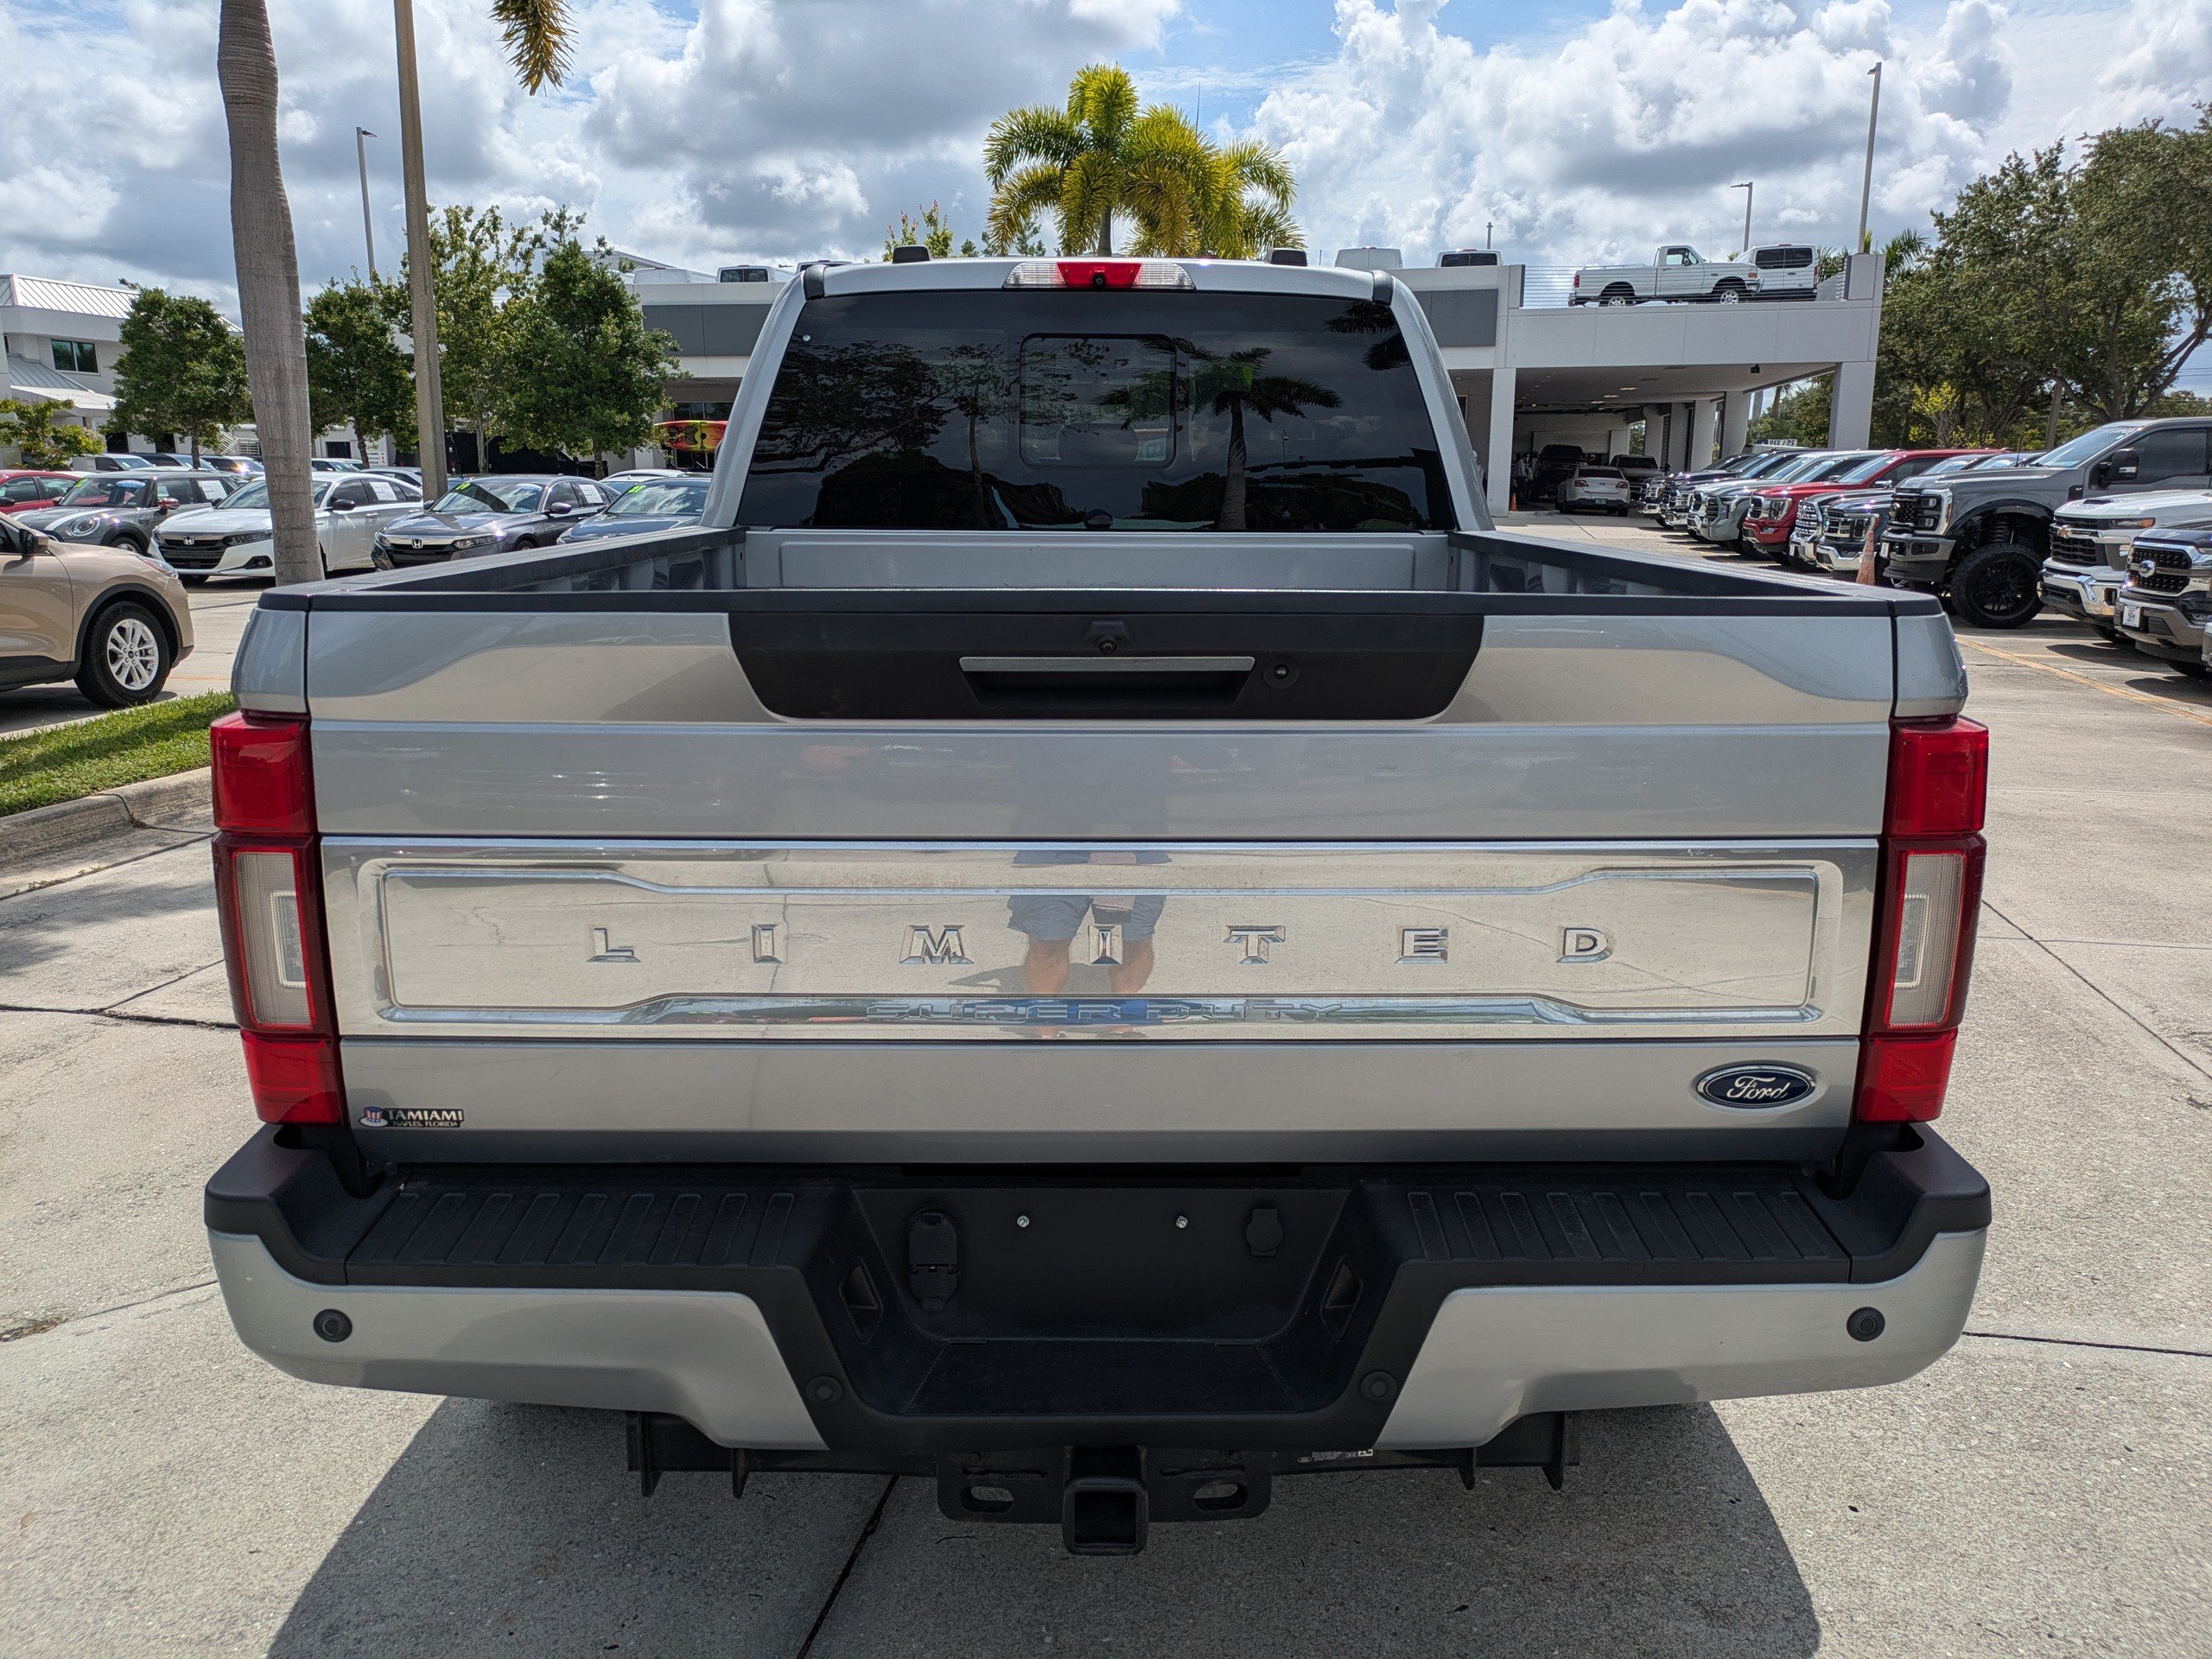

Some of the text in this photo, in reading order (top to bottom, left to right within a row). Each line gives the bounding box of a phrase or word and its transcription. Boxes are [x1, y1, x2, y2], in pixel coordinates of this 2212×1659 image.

[587, 924, 1613, 964] LIMITED
[866, 1003, 1342, 1020] SUPER DUTY
[1726, 1076, 1790, 1100] Ford
[388, 1109, 463, 1121] TAMIAMI
